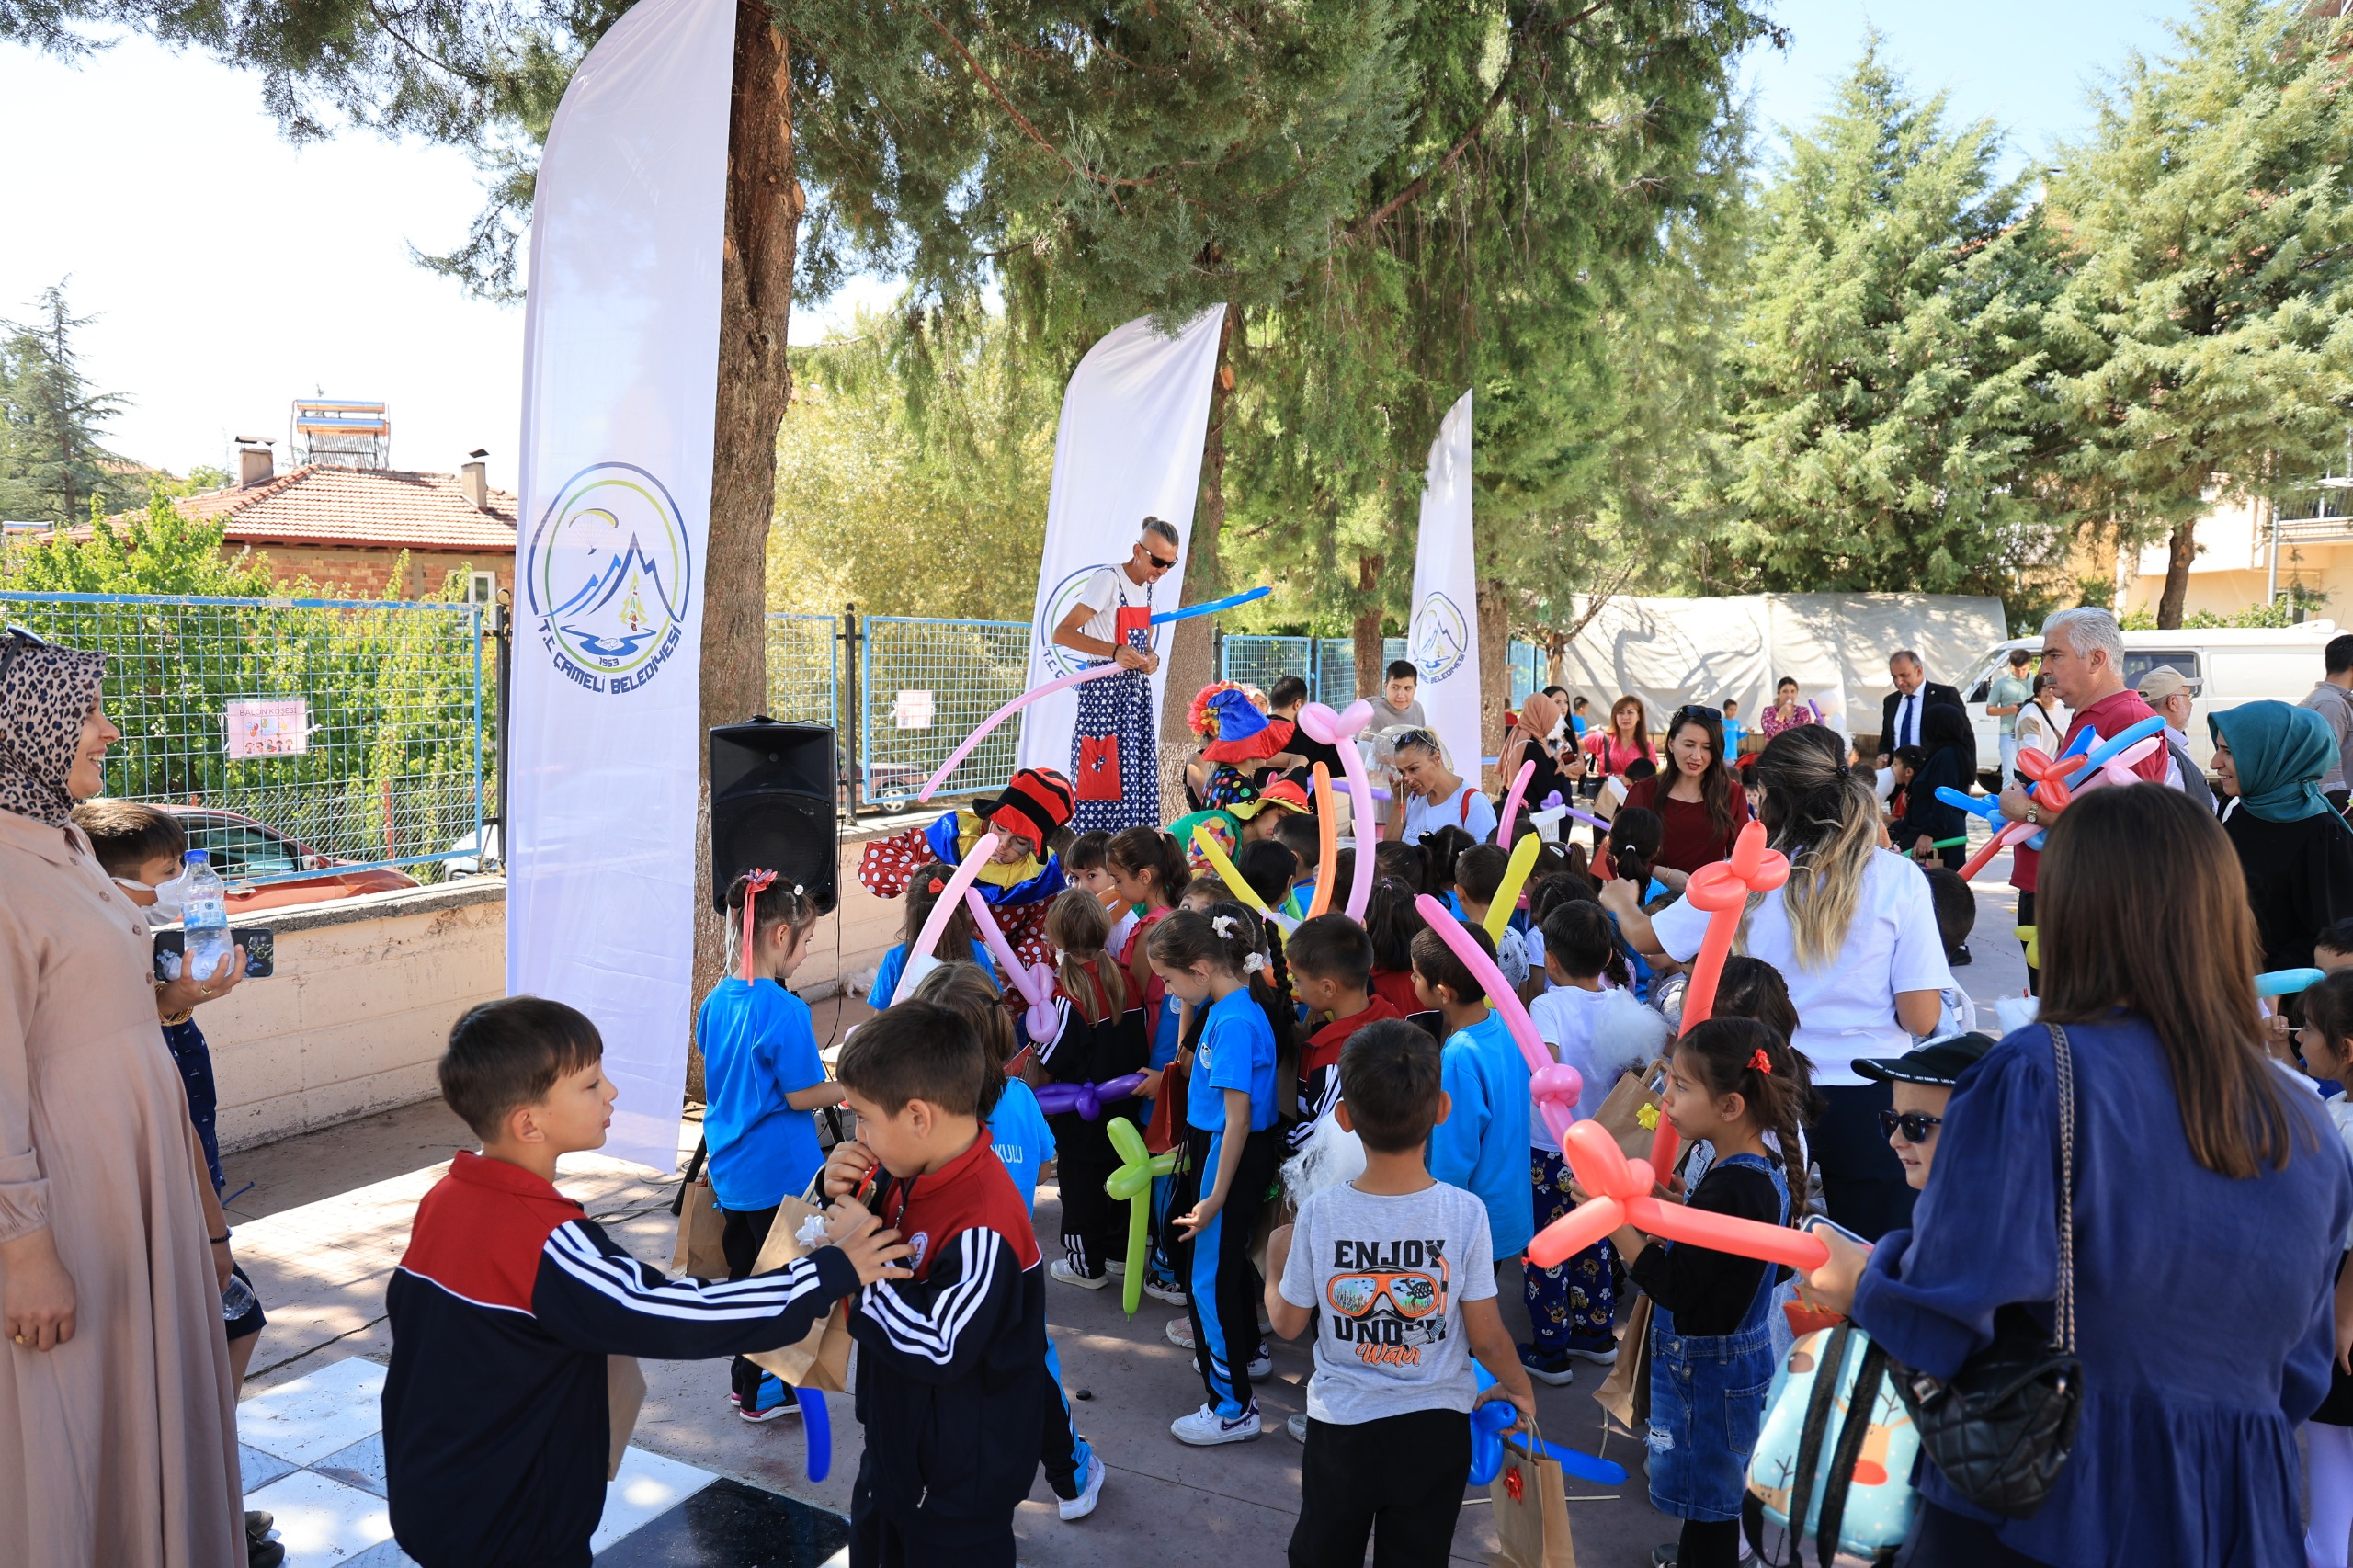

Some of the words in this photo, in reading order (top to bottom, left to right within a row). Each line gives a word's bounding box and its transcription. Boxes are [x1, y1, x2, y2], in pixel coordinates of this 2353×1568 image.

[553, 651, 606, 693] ÇAMELİ
[610, 623, 682, 695] BELEDİYESİ
[599, 656, 620, 667] 1953
[1334, 1240, 1446, 1268] ENJOY
[1356, 1342, 1421, 1367] Water
